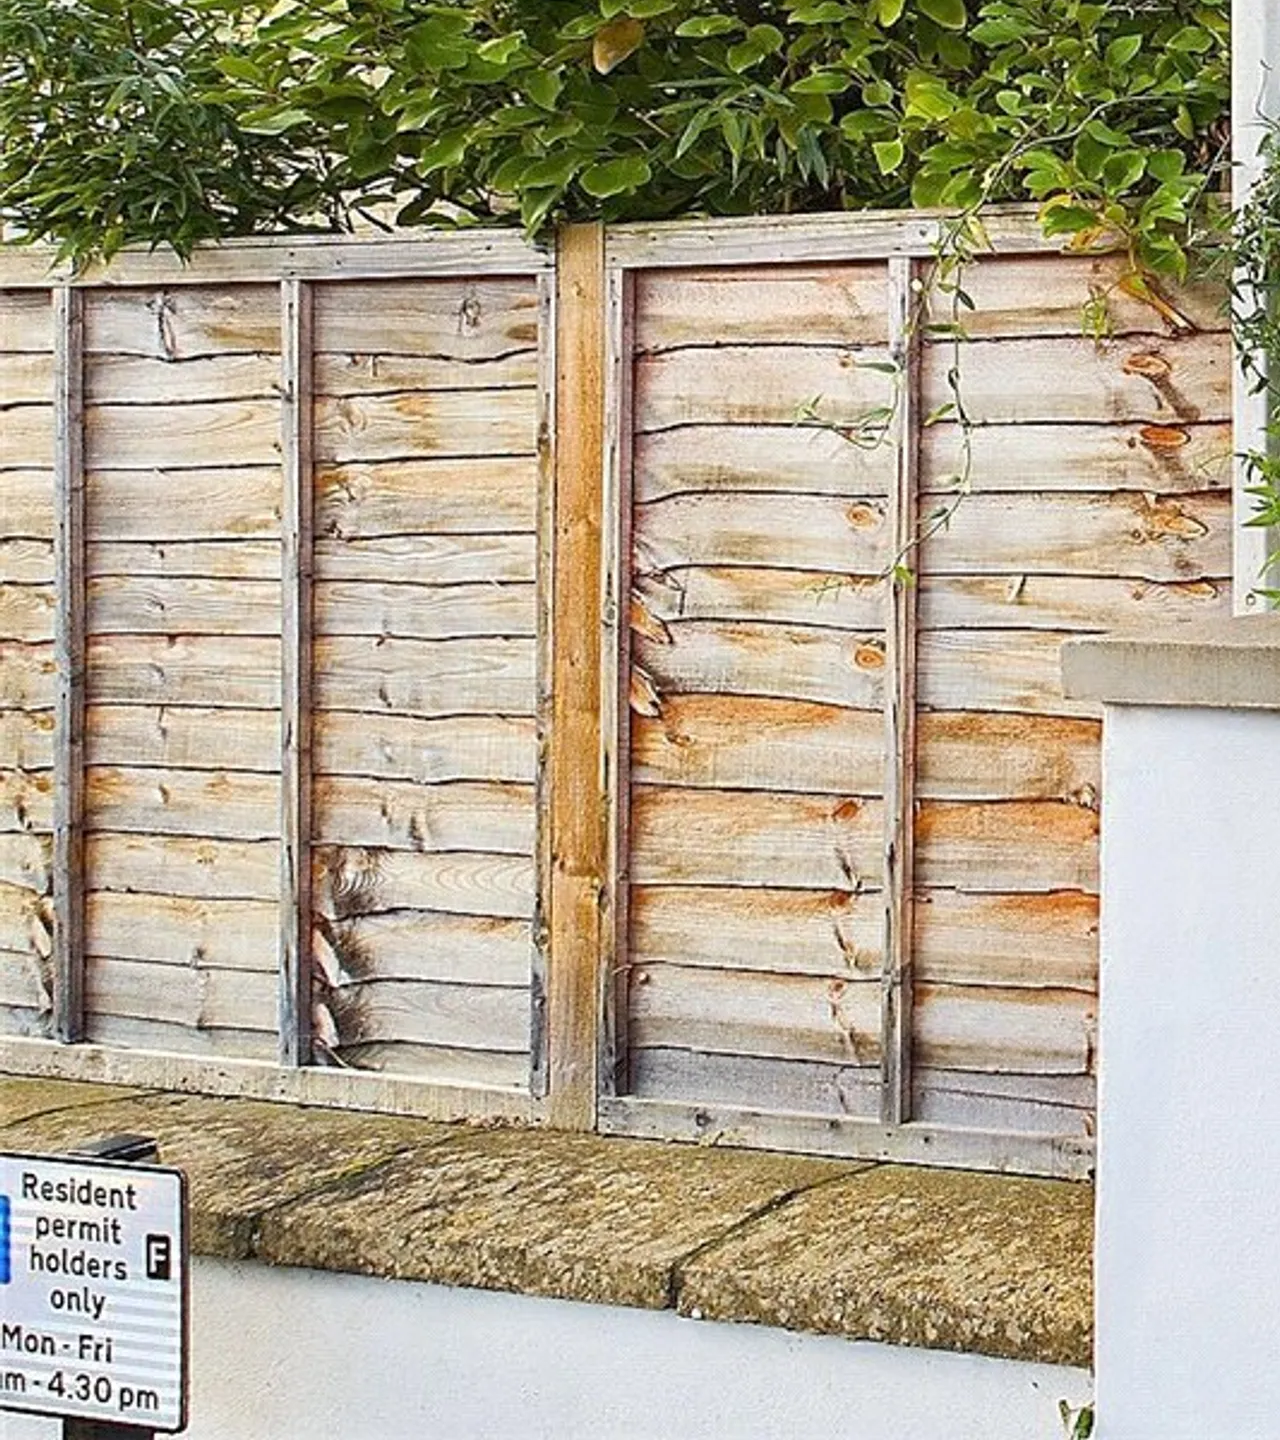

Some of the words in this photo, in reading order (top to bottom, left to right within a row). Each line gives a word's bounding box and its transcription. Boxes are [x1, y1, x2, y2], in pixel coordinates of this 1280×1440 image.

[22, 1173, 137, 1210] Resident
[35, 1217, 121, 1244] permit
[30, 1246, 127, 1280] holders
[149, 1240, 168, 1273] F
[50, 1287, 106, 1319] only
[2, 1324, 55, 1355] Mon
[79, 1335, 112, 1363] Fri
[48, 1371, 112, 1403] 4.30
[119, 1387, 158, 1411] pm
